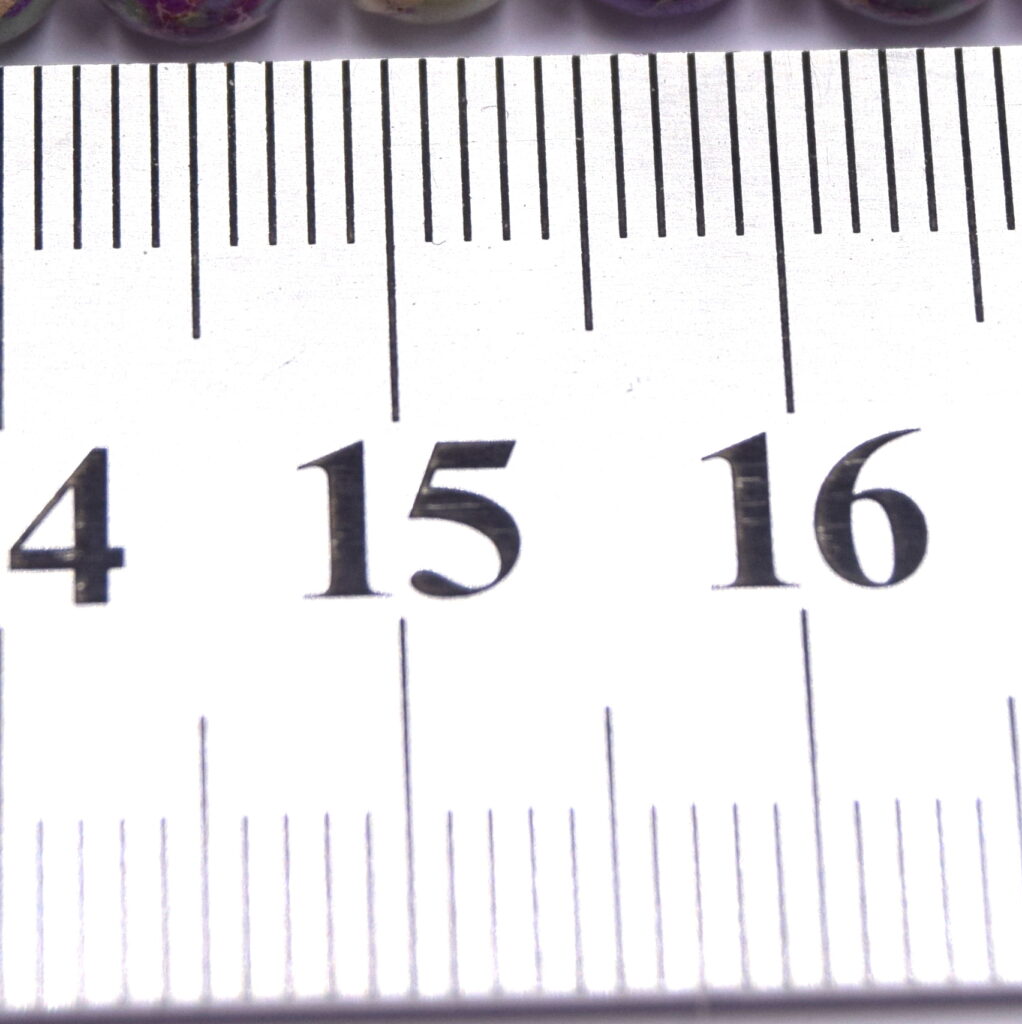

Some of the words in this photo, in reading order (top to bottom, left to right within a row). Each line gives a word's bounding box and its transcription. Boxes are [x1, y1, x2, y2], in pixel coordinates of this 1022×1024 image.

[9, 447, 126, 605] 4
[297, 440, 522, 599] 15
[702, 428, 928, 588] 16
